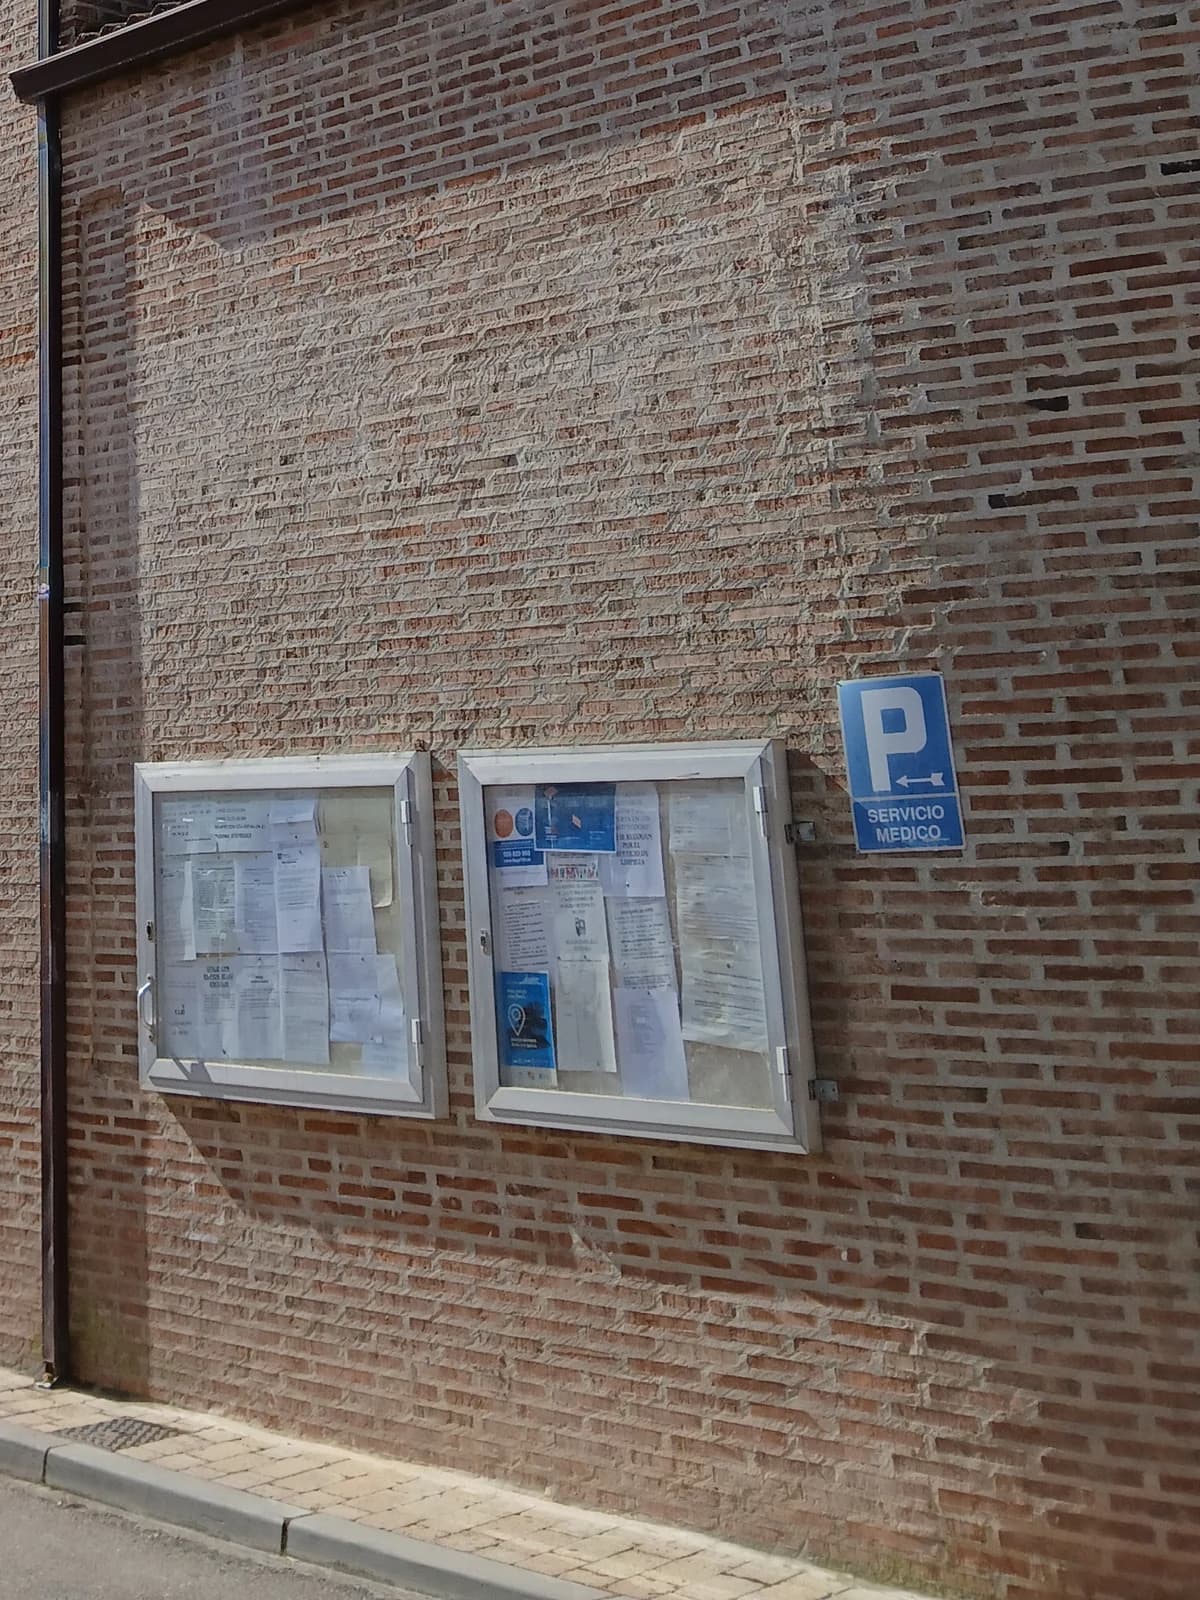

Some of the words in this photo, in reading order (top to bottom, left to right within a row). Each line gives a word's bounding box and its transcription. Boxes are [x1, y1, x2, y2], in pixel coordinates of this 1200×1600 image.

[860, 686, 927, 792] P
[867, 805, 945, 824] SERVICIO
[875, 824, 941, 844] MEDICO
